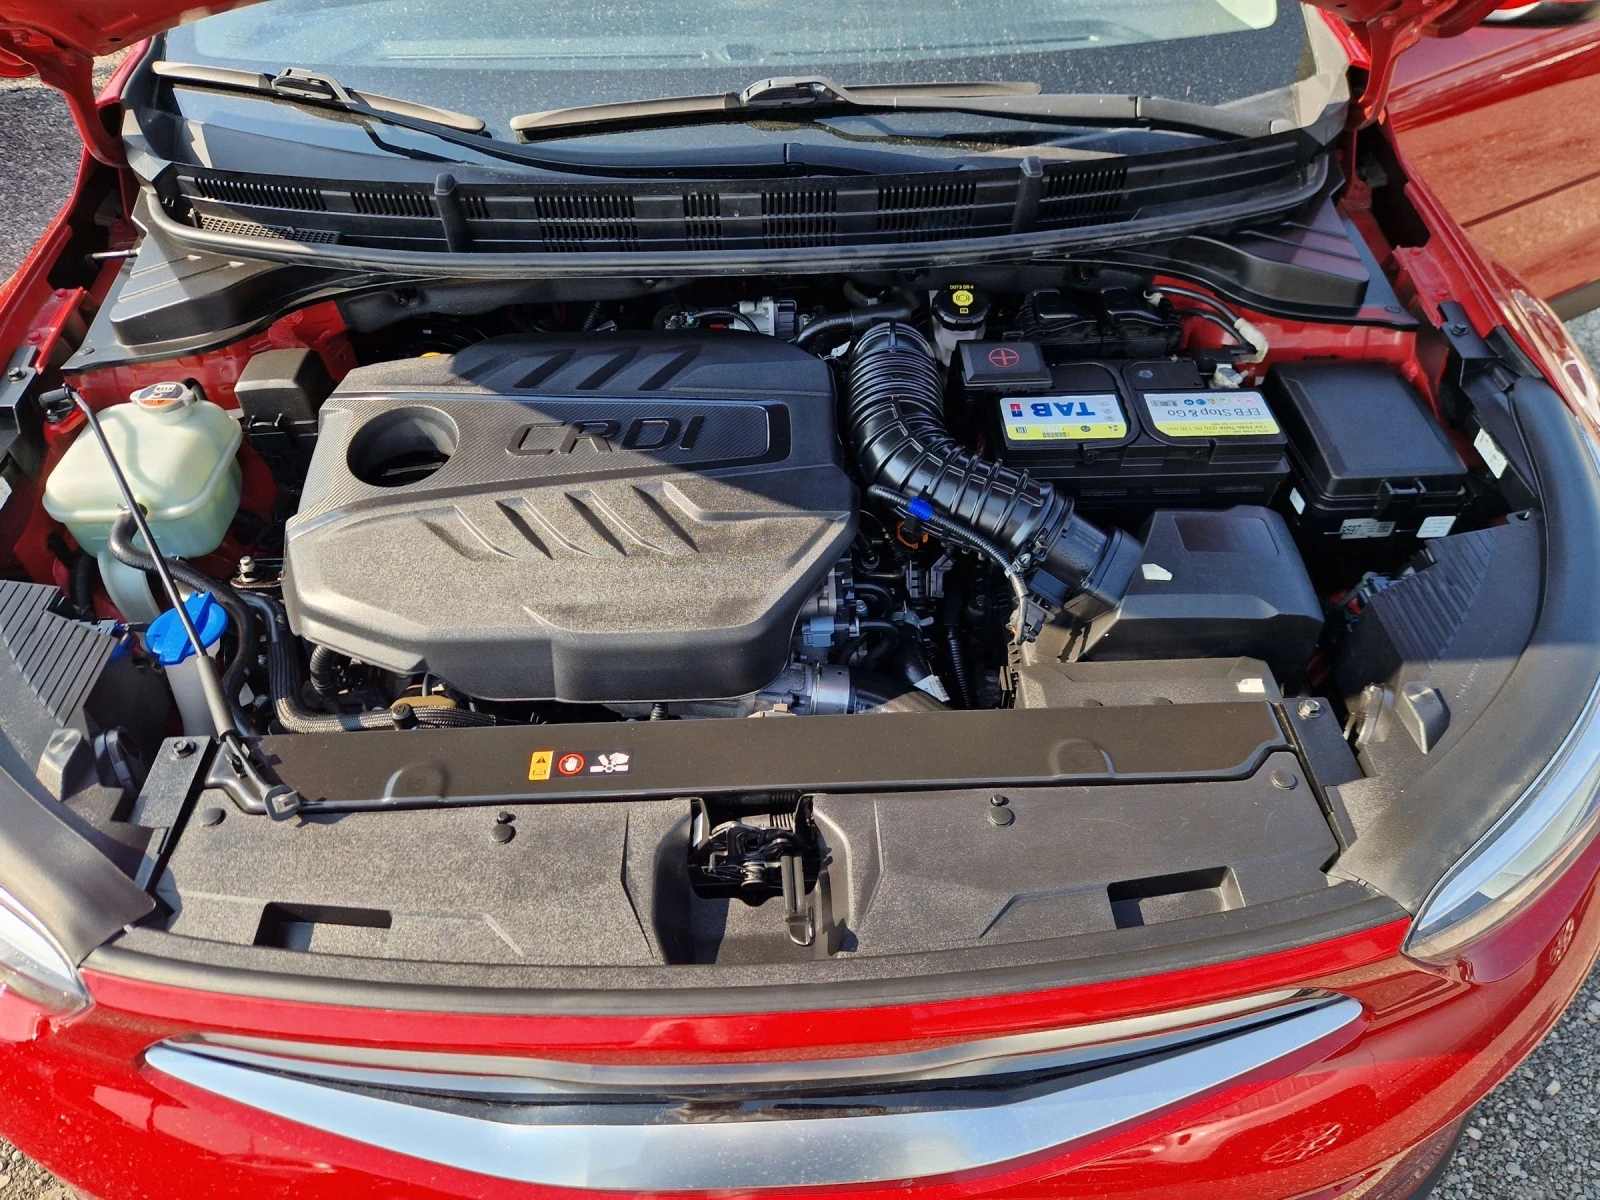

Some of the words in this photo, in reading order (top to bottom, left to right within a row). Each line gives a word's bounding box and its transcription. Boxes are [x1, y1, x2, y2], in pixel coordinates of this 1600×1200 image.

[1030, 402, 1096, 417] TAB
[1167, 409, 1187, 417] Go
[1188, 409, 1198, 417] &
[1200, 407, 1232, 417] Stop
[1233, 407, 1261, 416] EFB
[504, 414, 705, 456] CRDI
